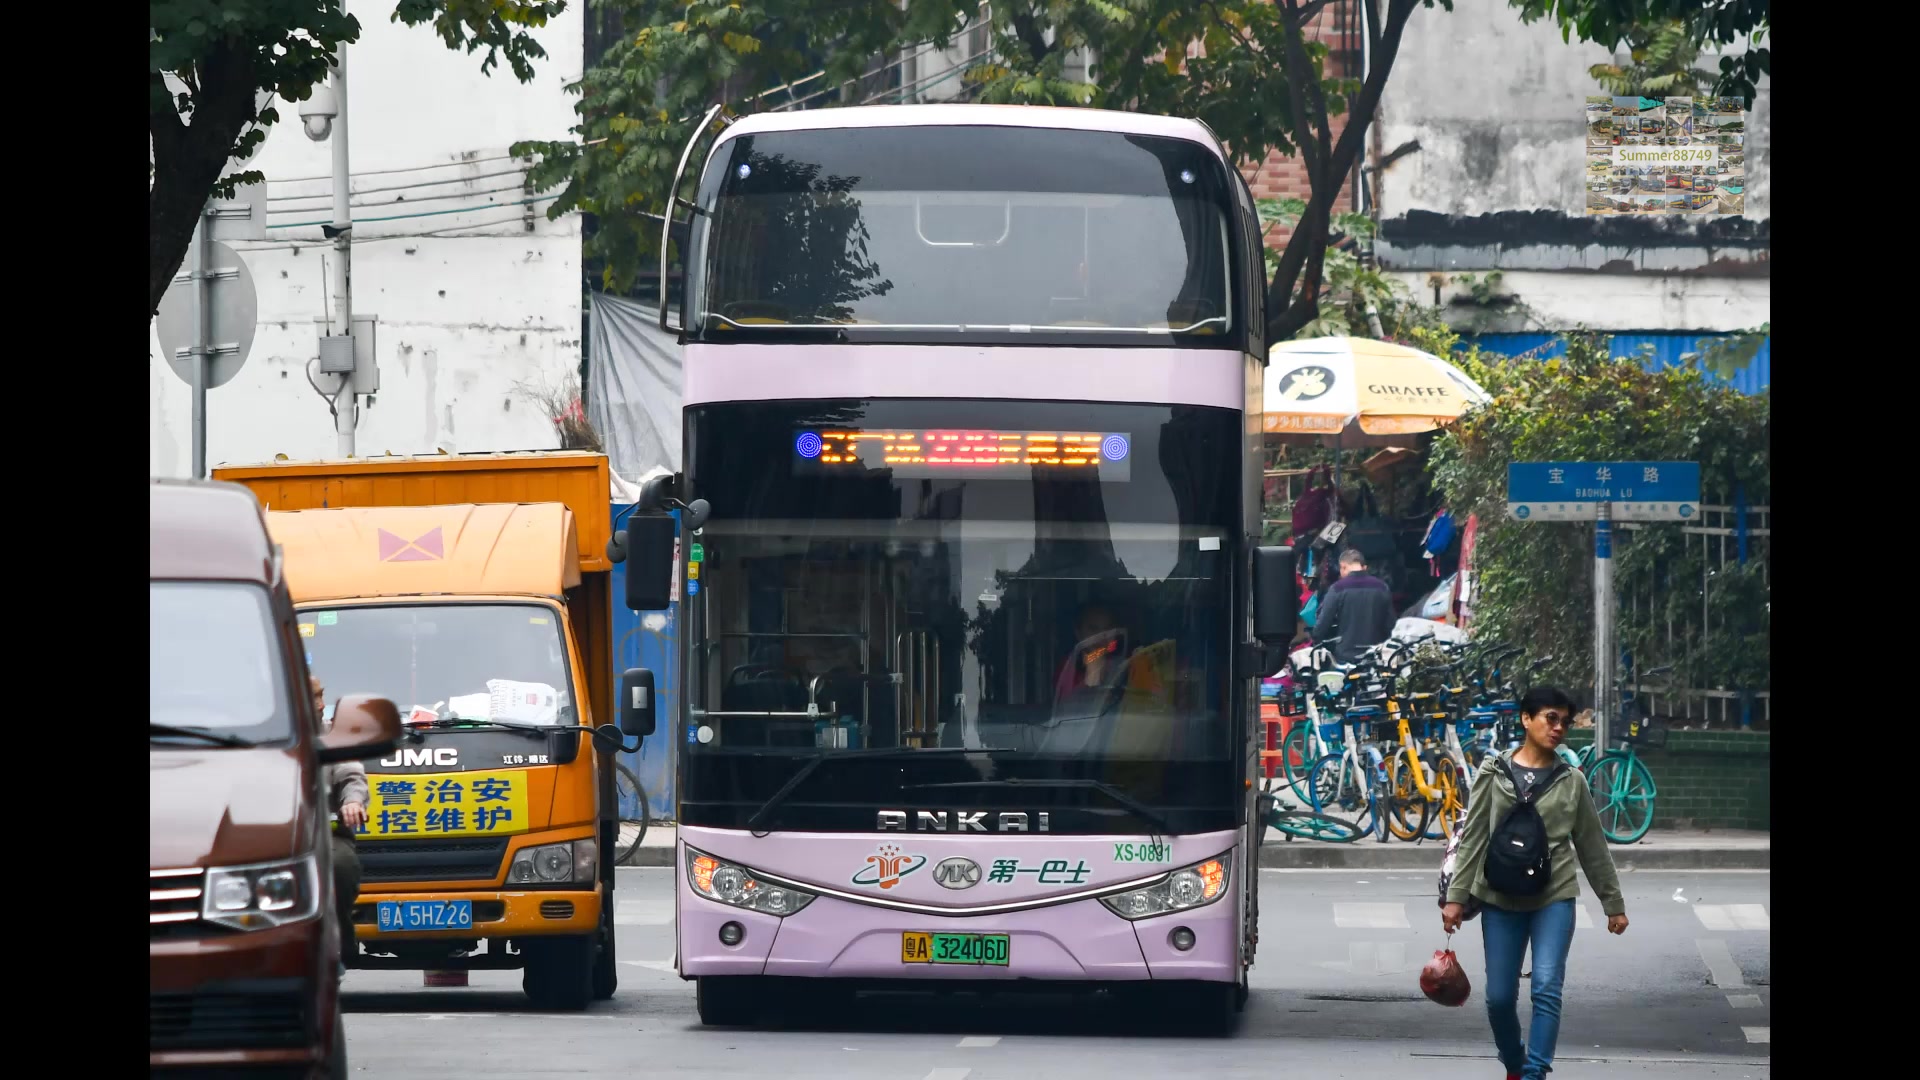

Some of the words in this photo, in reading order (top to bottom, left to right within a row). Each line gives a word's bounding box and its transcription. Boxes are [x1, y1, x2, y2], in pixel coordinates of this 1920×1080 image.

[1368, 384, 1450, 397] GIRAFFE
[1548, 466, 1660, 484] 宝华路
[1575, 488, 1611, 498] BAOHUA
[380, 748, 458, 767] JMC
[877, 810, 1050, 832] ANKAI
[987, 859, 1091, 884] 第一巴士
